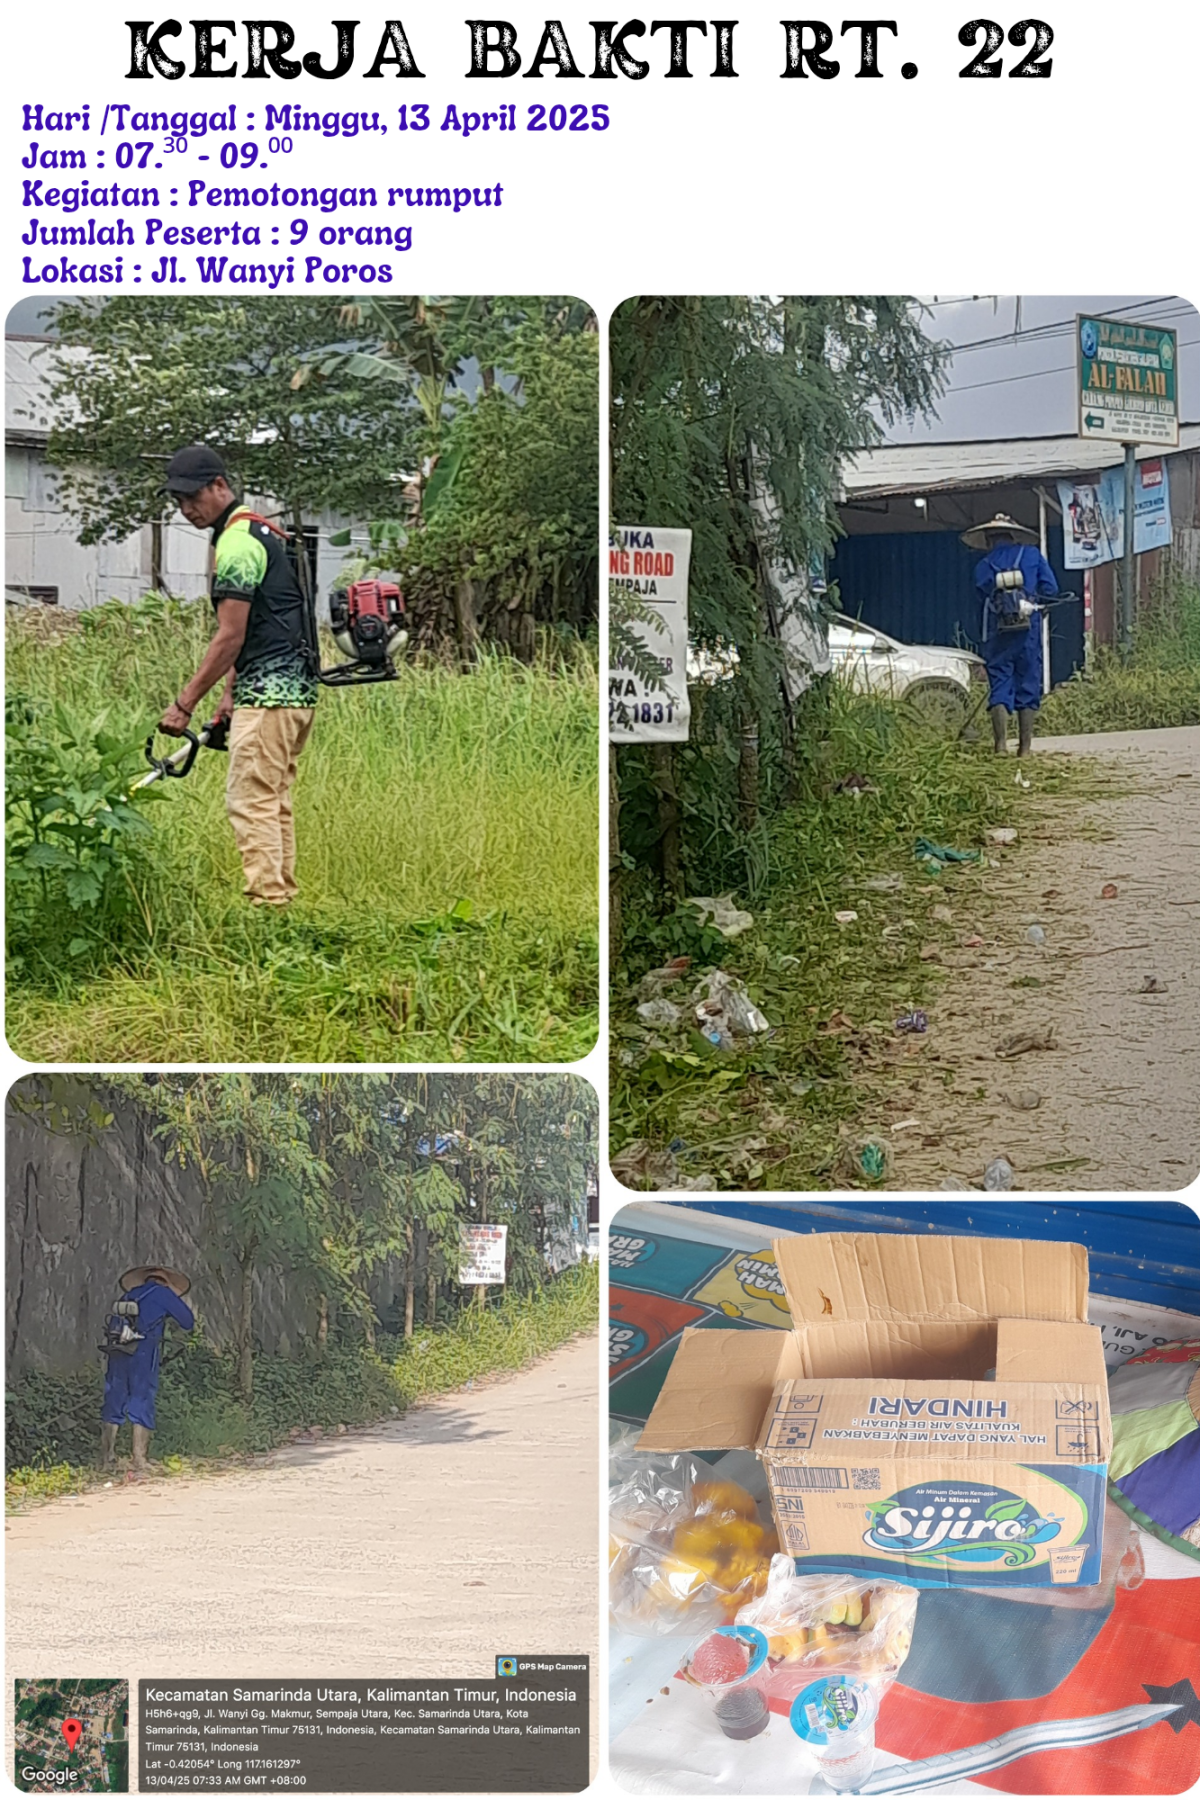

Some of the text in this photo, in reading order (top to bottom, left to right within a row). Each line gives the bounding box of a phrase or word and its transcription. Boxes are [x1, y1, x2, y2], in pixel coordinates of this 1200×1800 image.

[1087, 362, 1167, 396] AL-FALAH
[633, 550, 675, 578] ROAD
[608, 576, 658, 596] MPAJA
[632, 701, 674, 724] 1831
[1102, 1340, 1135, 1356] GU
[867, 1396, 1008, 1418] HINDARI
[860, 1418, 927, 1429] BERUBAH
[929, 1420, 952, 1430] AIR
[955, 1421, 1021, 1431] KUALITAS
[822, 1429, 1047, 1444] HAL YANG DAPAT MENYEBABKAN
[925, 1488, 948, 1496] Minum
[969, 1489, 999, 1497] Kemasan
[948, 1496, 981, 1504] Mineral
[775, 1496, 804, 1511] SNI
[866, 1505, 1026, 1552] Sijiro
